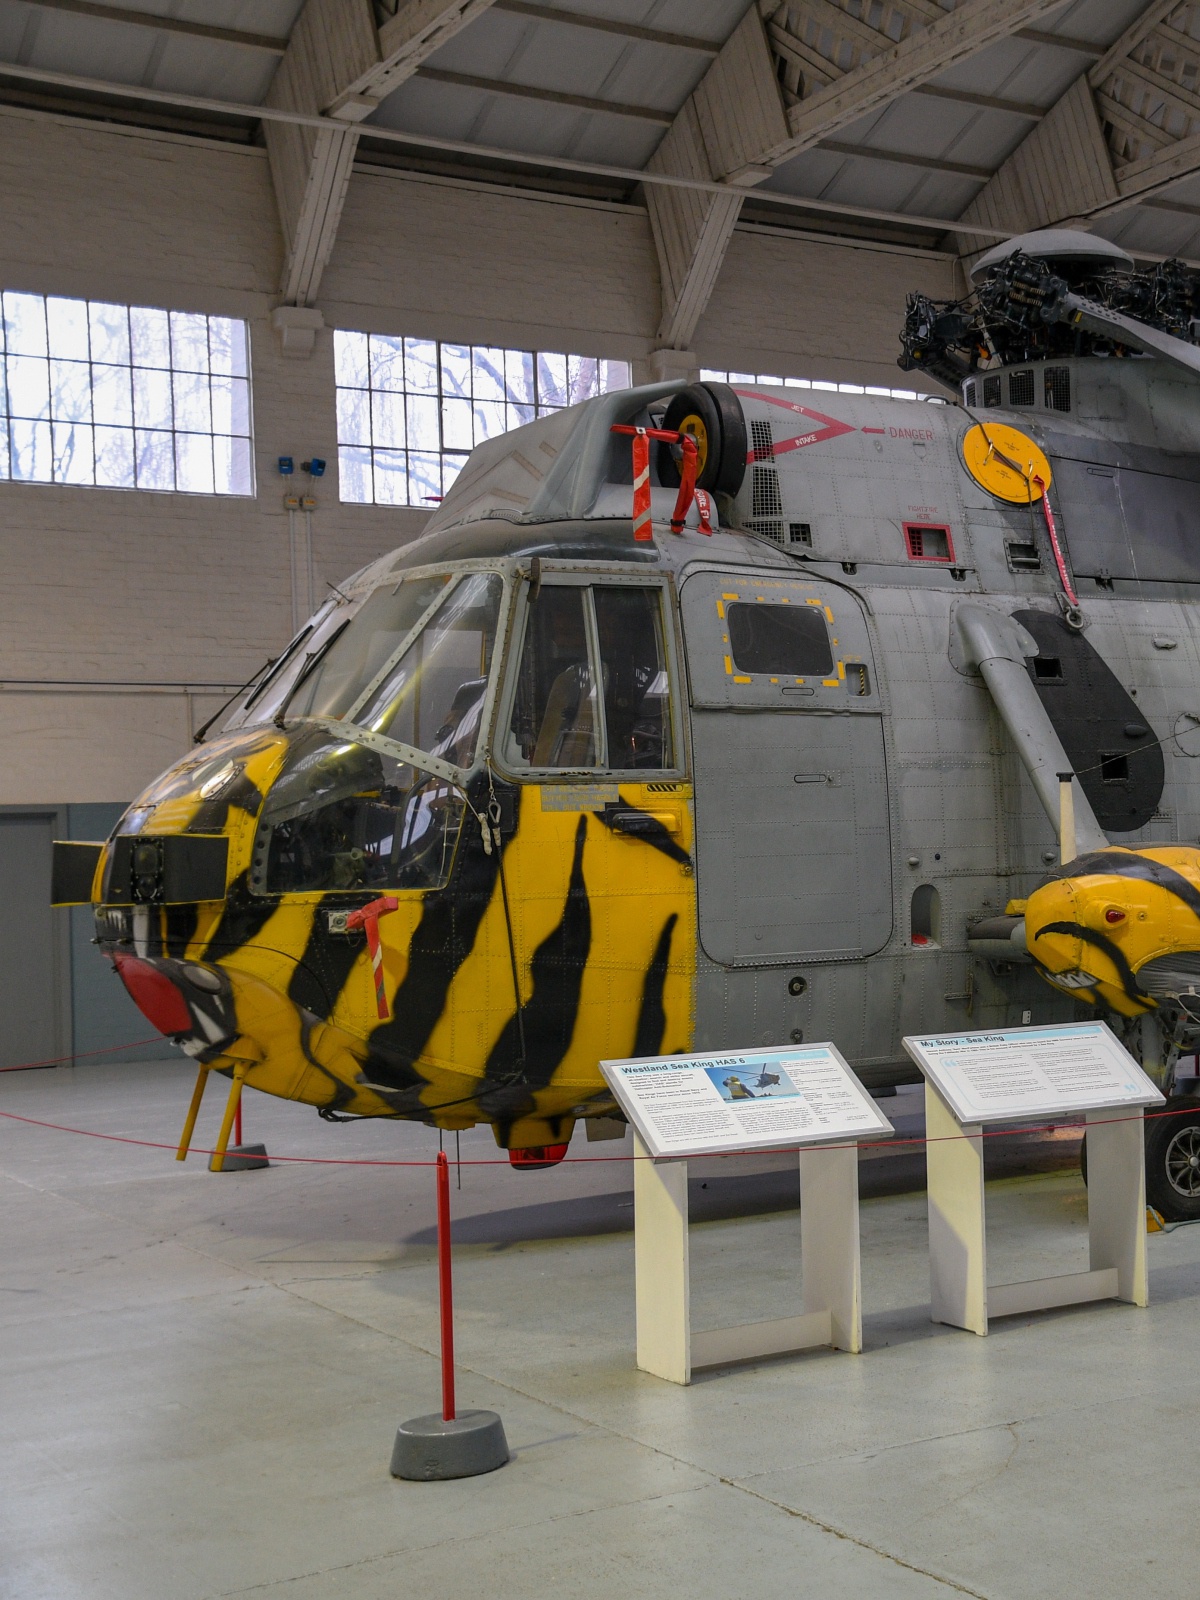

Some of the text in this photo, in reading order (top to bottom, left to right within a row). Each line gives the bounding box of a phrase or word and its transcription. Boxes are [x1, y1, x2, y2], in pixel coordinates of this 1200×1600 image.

[790, 404, 805, 414] JET
[888, 426, 934, 441] DANGER
[794, 434, 818, 446] INTAKE
[935, 1037, 959, 1047] Story
[967, 1036, 983, 1044] Sea
[983, 1035, 1005, 1044] King
[621, 1063, 669, 1075] Westland
[670, 1062, 690, 1070] Sea
[690, 1059, 715, 1070] King
[715, 1057, 737, 1067] HAS
